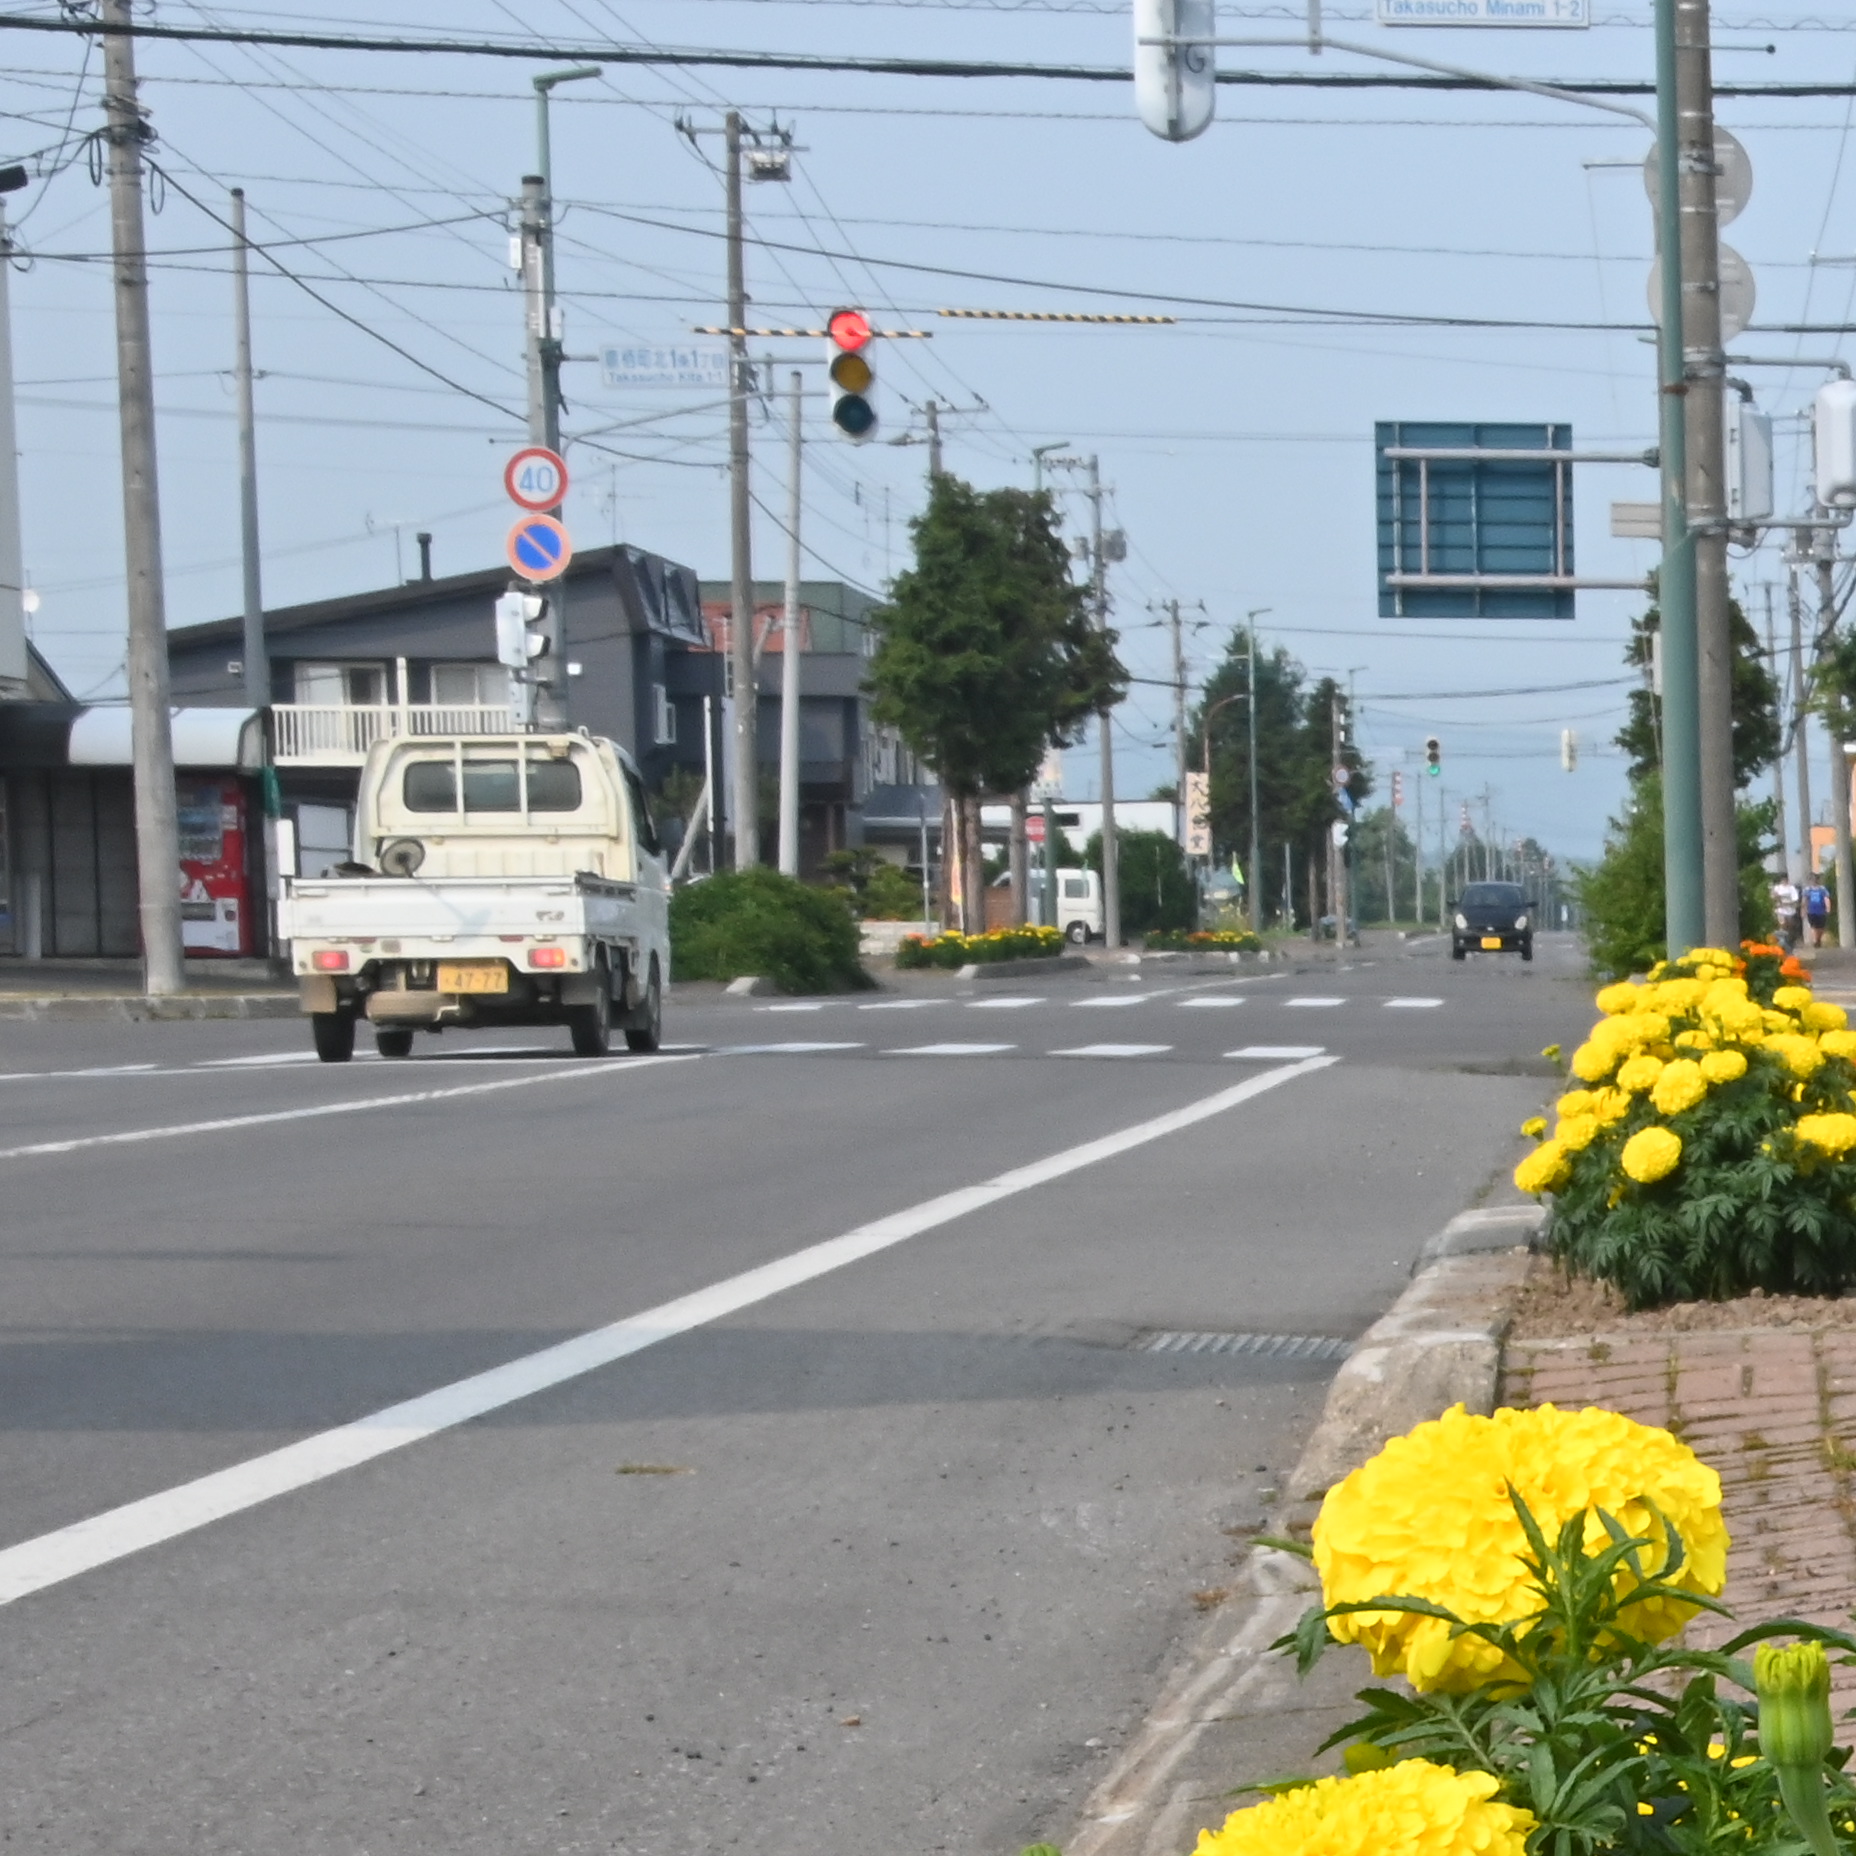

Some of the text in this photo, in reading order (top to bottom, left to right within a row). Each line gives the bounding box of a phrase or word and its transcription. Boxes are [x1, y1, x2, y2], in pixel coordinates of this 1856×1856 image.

[1386, 0, 1580, 17] Takasucho Minami 1-2
[519, 465, 553, 492] 40
